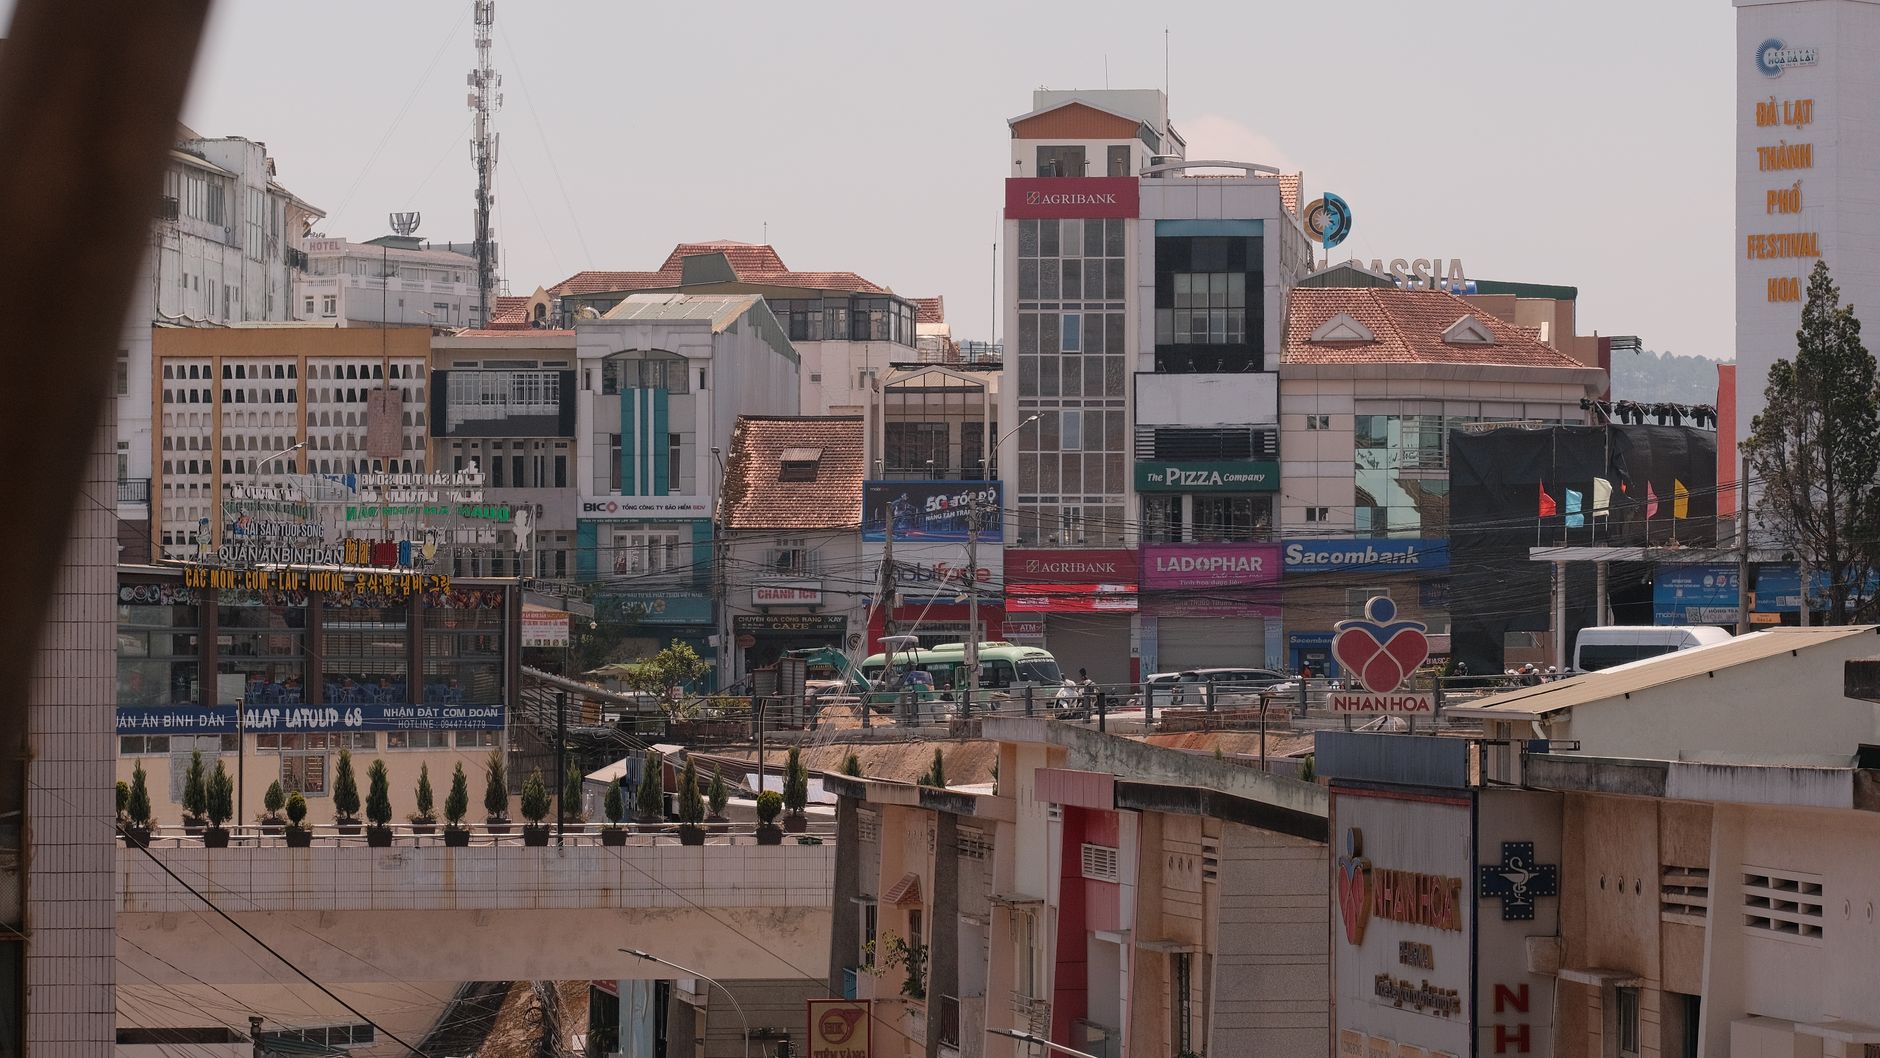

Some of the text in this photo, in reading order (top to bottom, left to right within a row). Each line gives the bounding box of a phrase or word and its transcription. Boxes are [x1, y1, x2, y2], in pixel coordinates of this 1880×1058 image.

[1756, 95, 1815, 130] ĐÀ LẠT
[1757, 139, 1813, 172] THÀNH
[1041, 193, 1117, 205] AGRIBANK
[1767, 179, 1803, 215] PHỐ
[309, 240, 341, 251] HOTEL
[1747, 232, 1822, 260] FESTIVAL
[1767, 278, 1802, 303] HOA
[1147, 467, 1265, 485] The PIZZA Company
[583, 502, 606, 512] BIC
[1284, 543, 1420, 565] Sacombank
[1041, 563, 1116, 574] AGRIBANK
[1156, 556, 1264, 572] LADOPHAR
[1020, 623, 1037, 632] ATM
[141, 712, 158, 728] ĂN
[163, 711, 194, 728] BÌNH
[199, 712, 225, 728] DÂN
[285, 708, 339, 728] LATULIP
[344, 707, 363, 727] 68
[398, 719, 434, 729] HOTLINE
